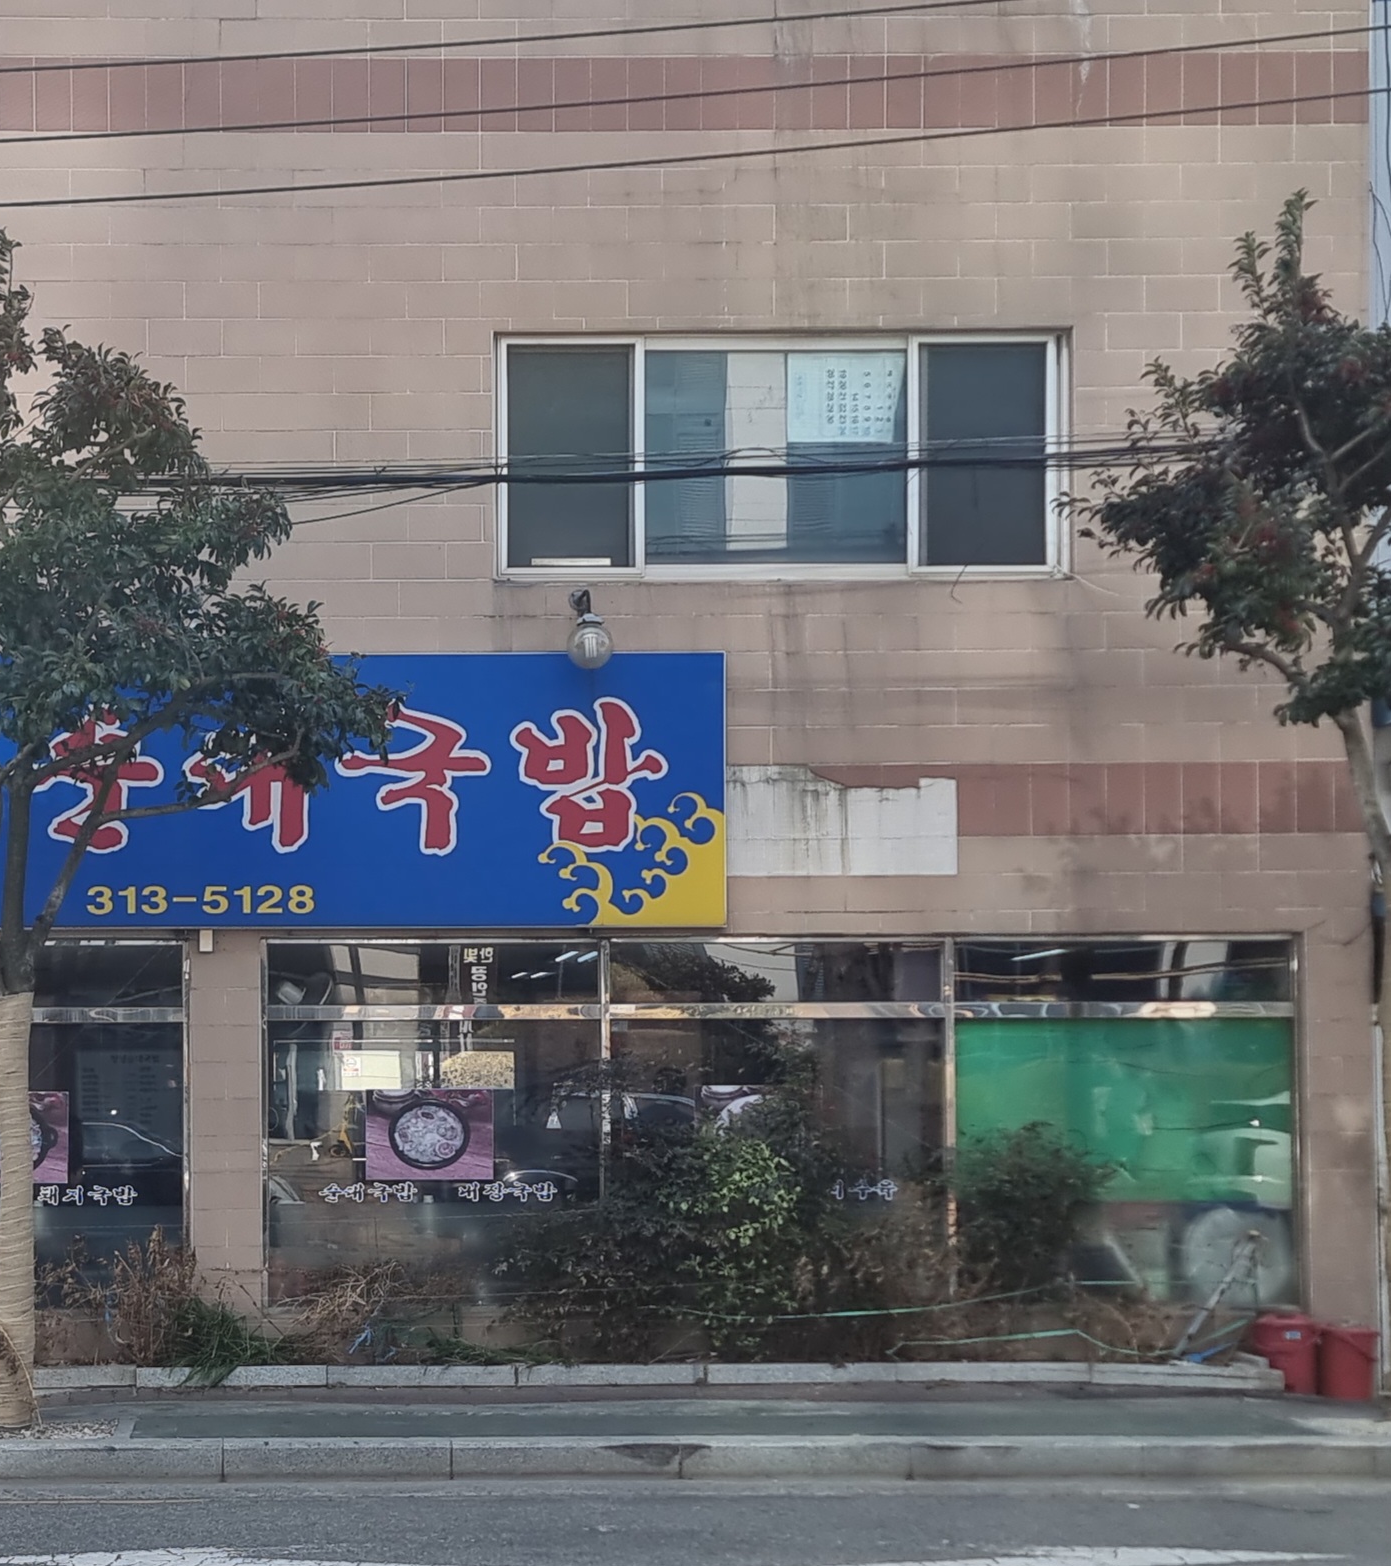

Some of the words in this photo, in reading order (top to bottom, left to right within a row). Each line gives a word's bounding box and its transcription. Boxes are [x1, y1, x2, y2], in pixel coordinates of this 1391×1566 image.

[86, 885, 315, 915] 313-5128
[37, 1185, 138, 1207] 돼지국밥
[319, 1181, 419, 1204] 순대국밥
